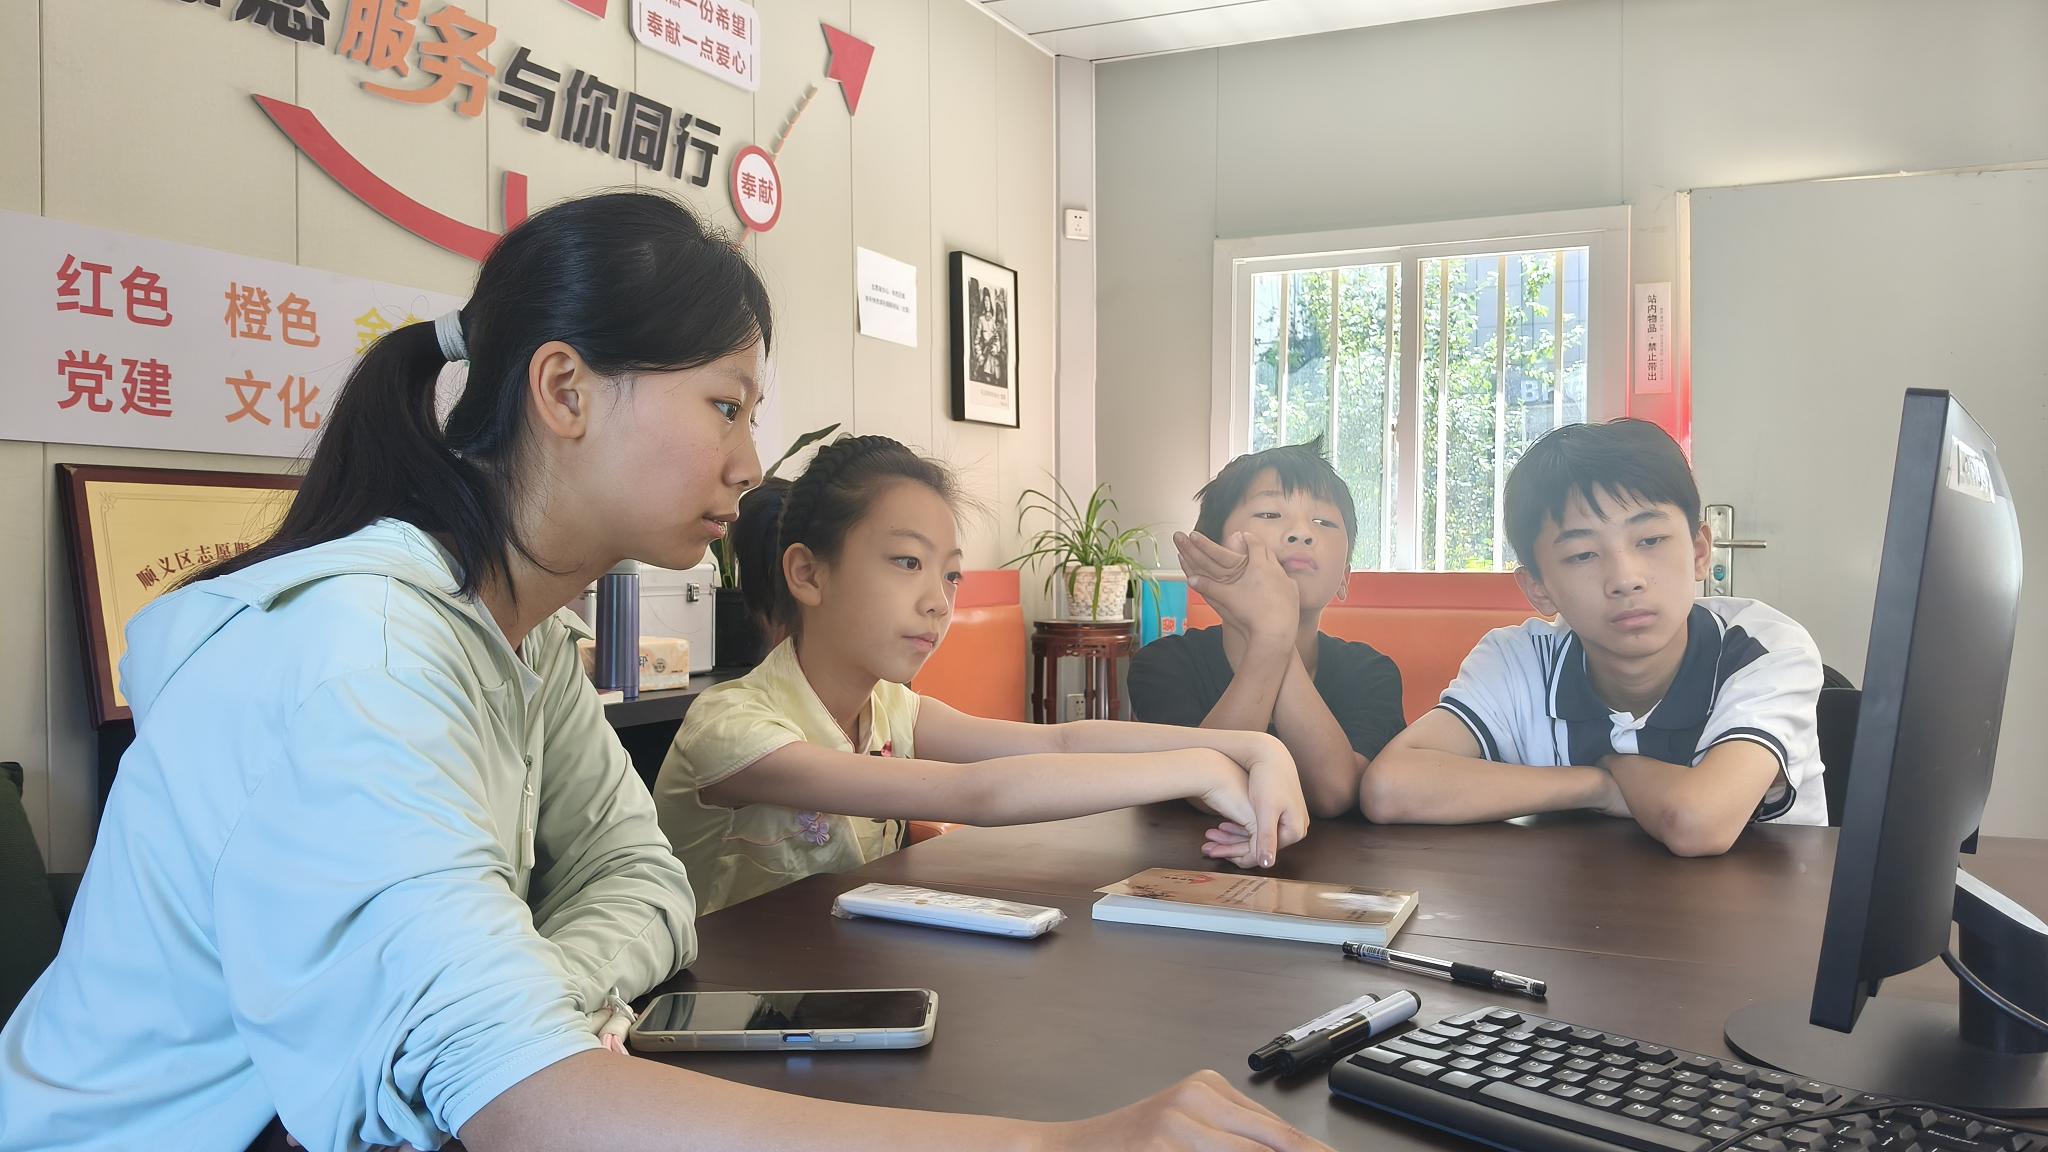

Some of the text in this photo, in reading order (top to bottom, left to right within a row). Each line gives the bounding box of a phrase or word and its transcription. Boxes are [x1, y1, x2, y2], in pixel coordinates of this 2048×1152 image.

[647, 10, 746, 75] 奉献一点爱心
[665, 0, 746, 39] 一份希望
[740, 171, 774, 205] 奉献
[56, 253, 425, 355] 红色 橙色 金
[57, 349, 321, 430] 党建 文化
